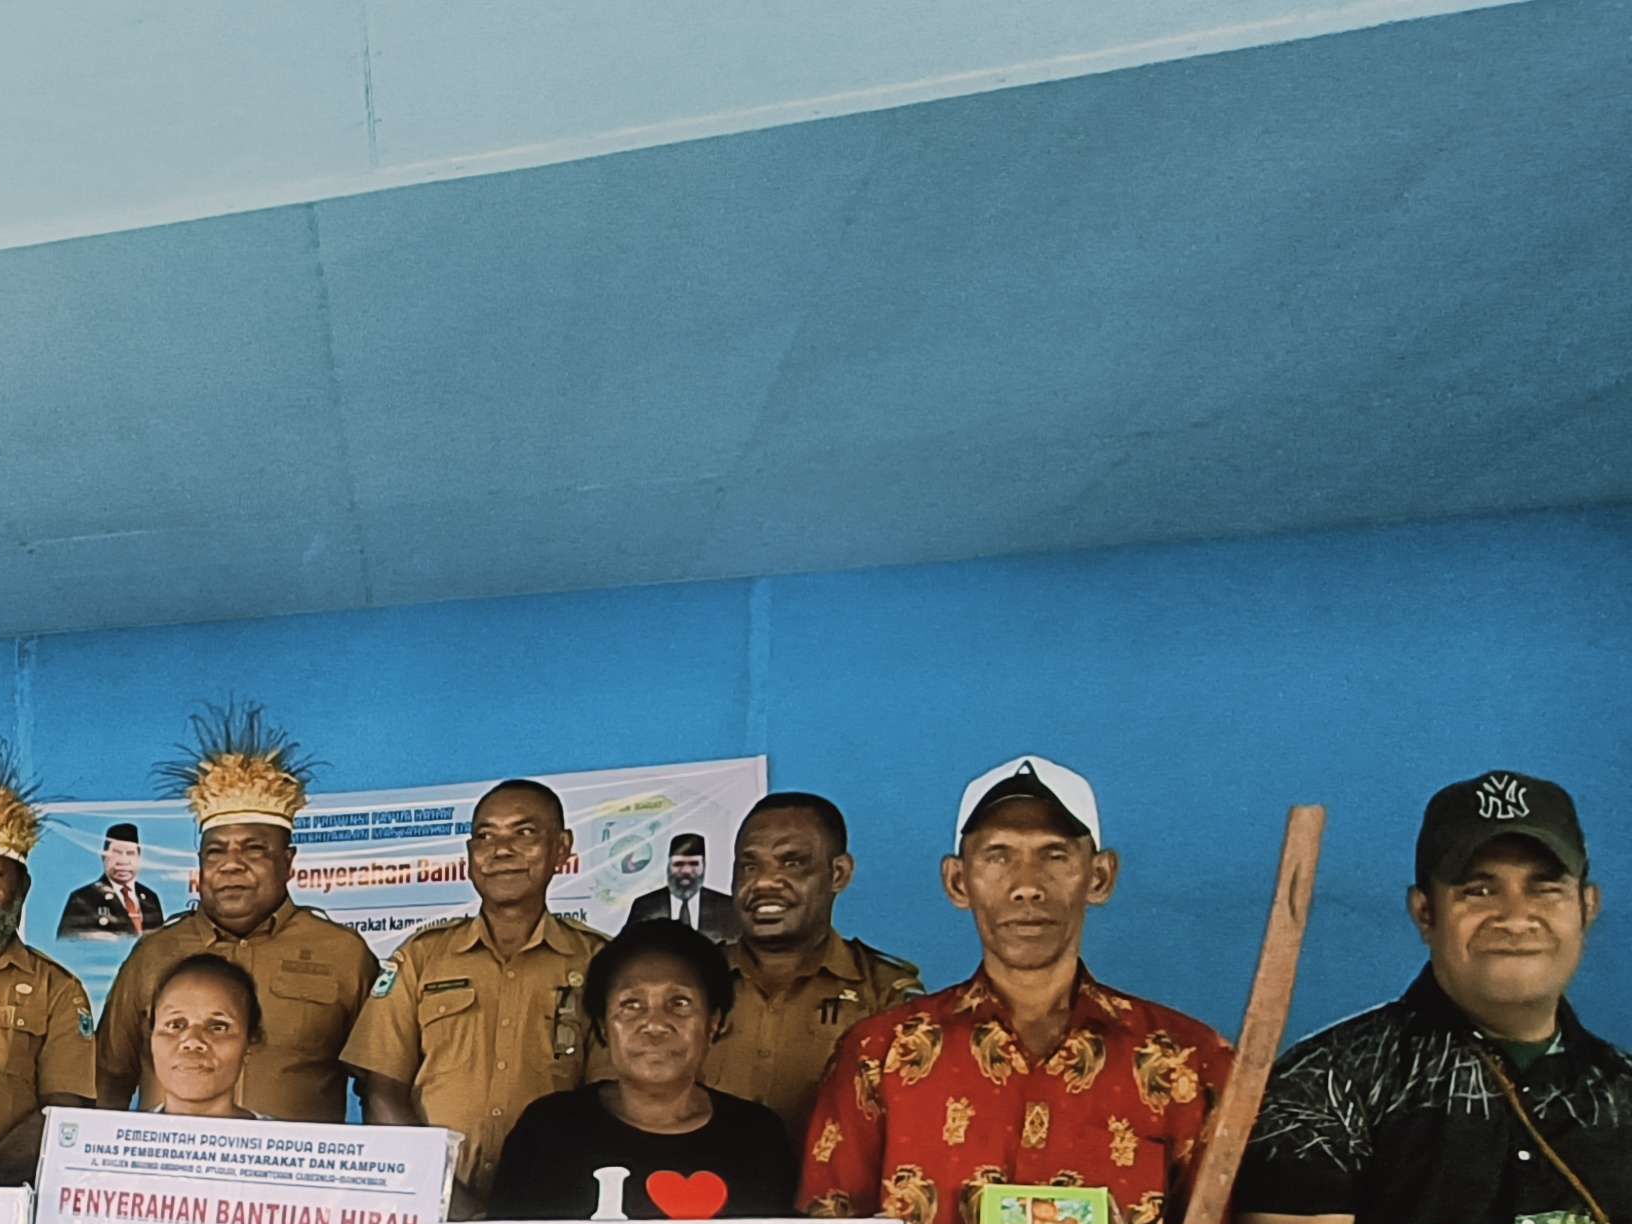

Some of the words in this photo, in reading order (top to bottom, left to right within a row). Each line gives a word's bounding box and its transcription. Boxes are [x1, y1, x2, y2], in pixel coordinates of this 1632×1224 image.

[290, 861, 411, 893] enyerahan
[116, 1128, 196, 1145] PEMERINTAH
[200, 1134, 262, 1150] PROVINSI
[267, 1139, 313, 1153] PAPUA
[318, 1142, 365, 1156] BARAT
[84, 1143, 120, 1156] DINAS
[123, 1146, 217, 1163] PEMBERDAYAAN
[220, 1152, 305, 1168] MASYARAKAT
[309, 1158, 336, 1170] DAN
[340, 1160, 406, 1174] KAMPUNG
[590, 1166, 632, 1221] I
